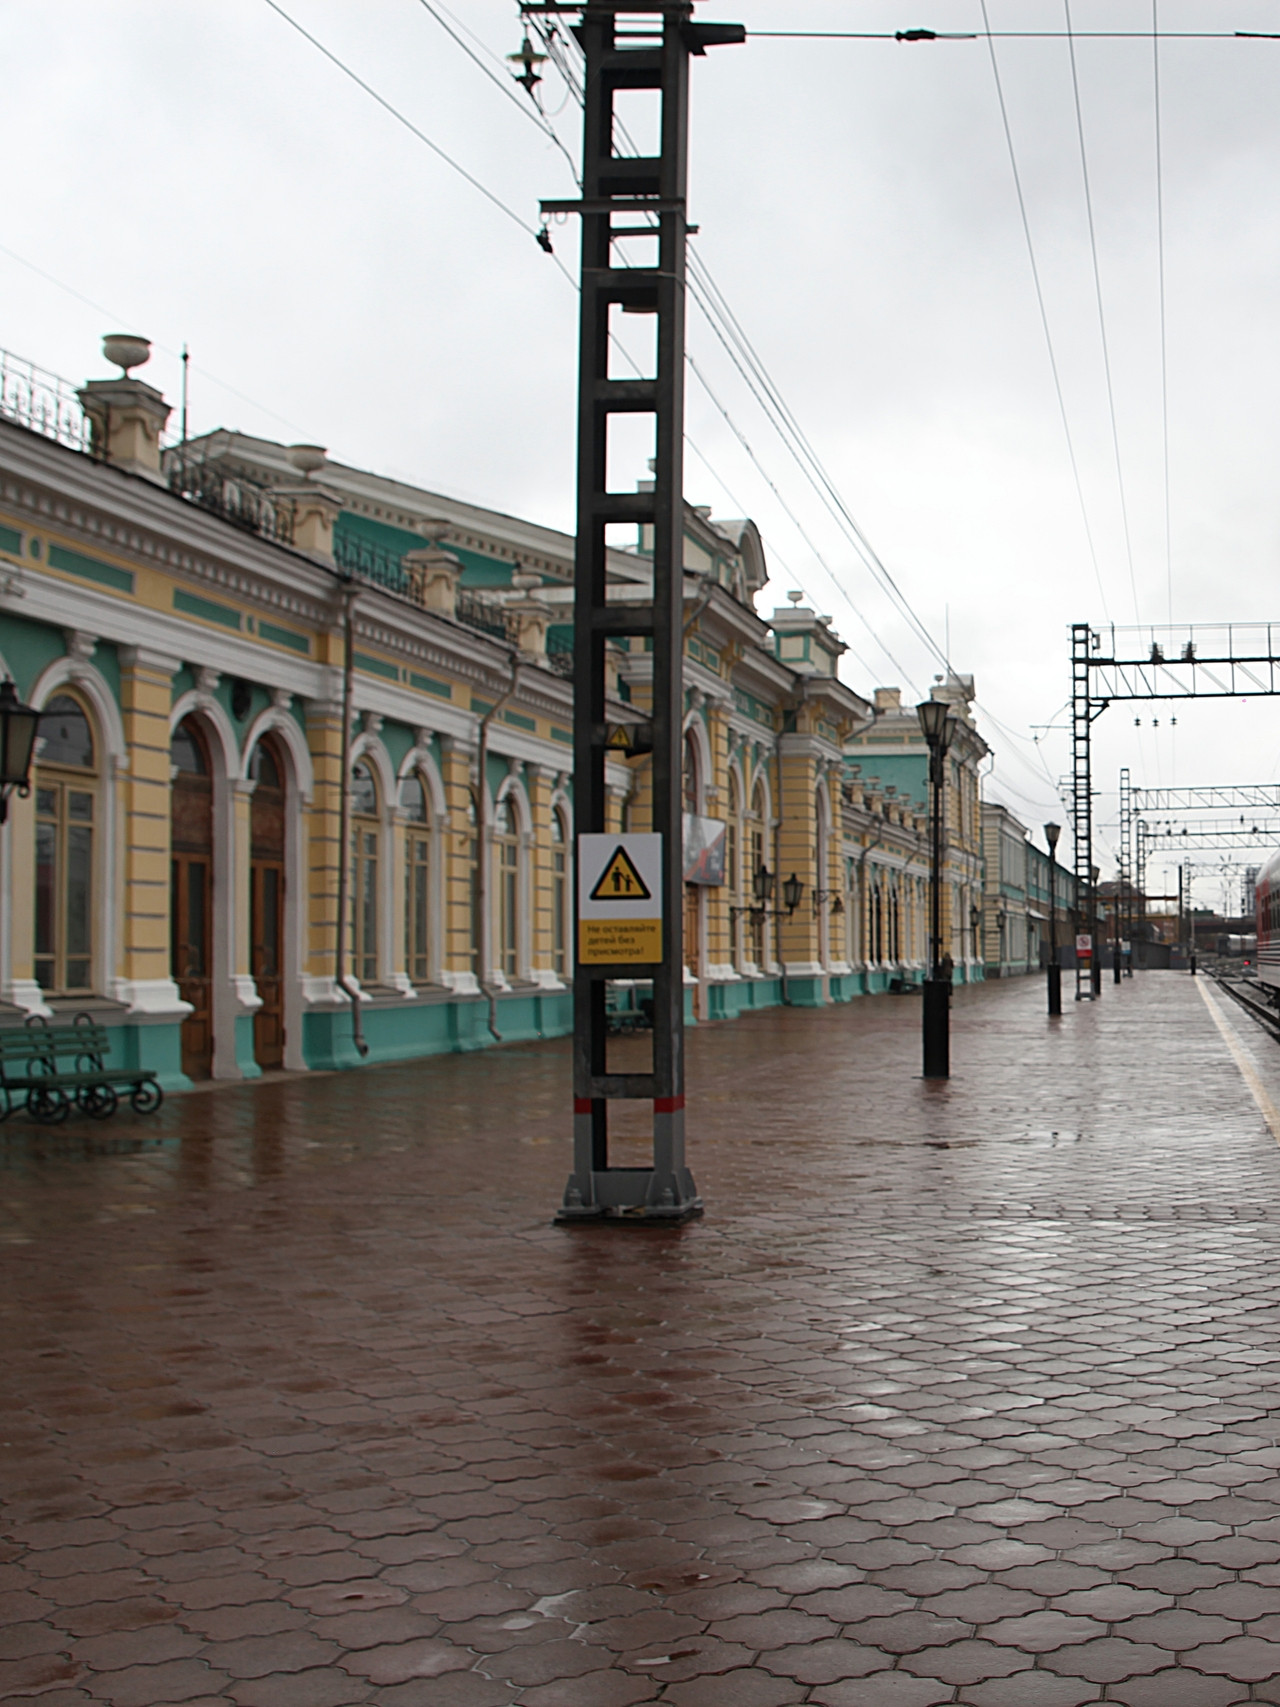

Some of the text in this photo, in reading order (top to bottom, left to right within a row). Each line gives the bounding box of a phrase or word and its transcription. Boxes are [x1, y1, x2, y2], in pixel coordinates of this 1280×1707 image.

[587, 924, 656, 933] Не оставляйте
[588, 934, 635, 945] детей без
[587, 946, 644, 957] присмотра!
